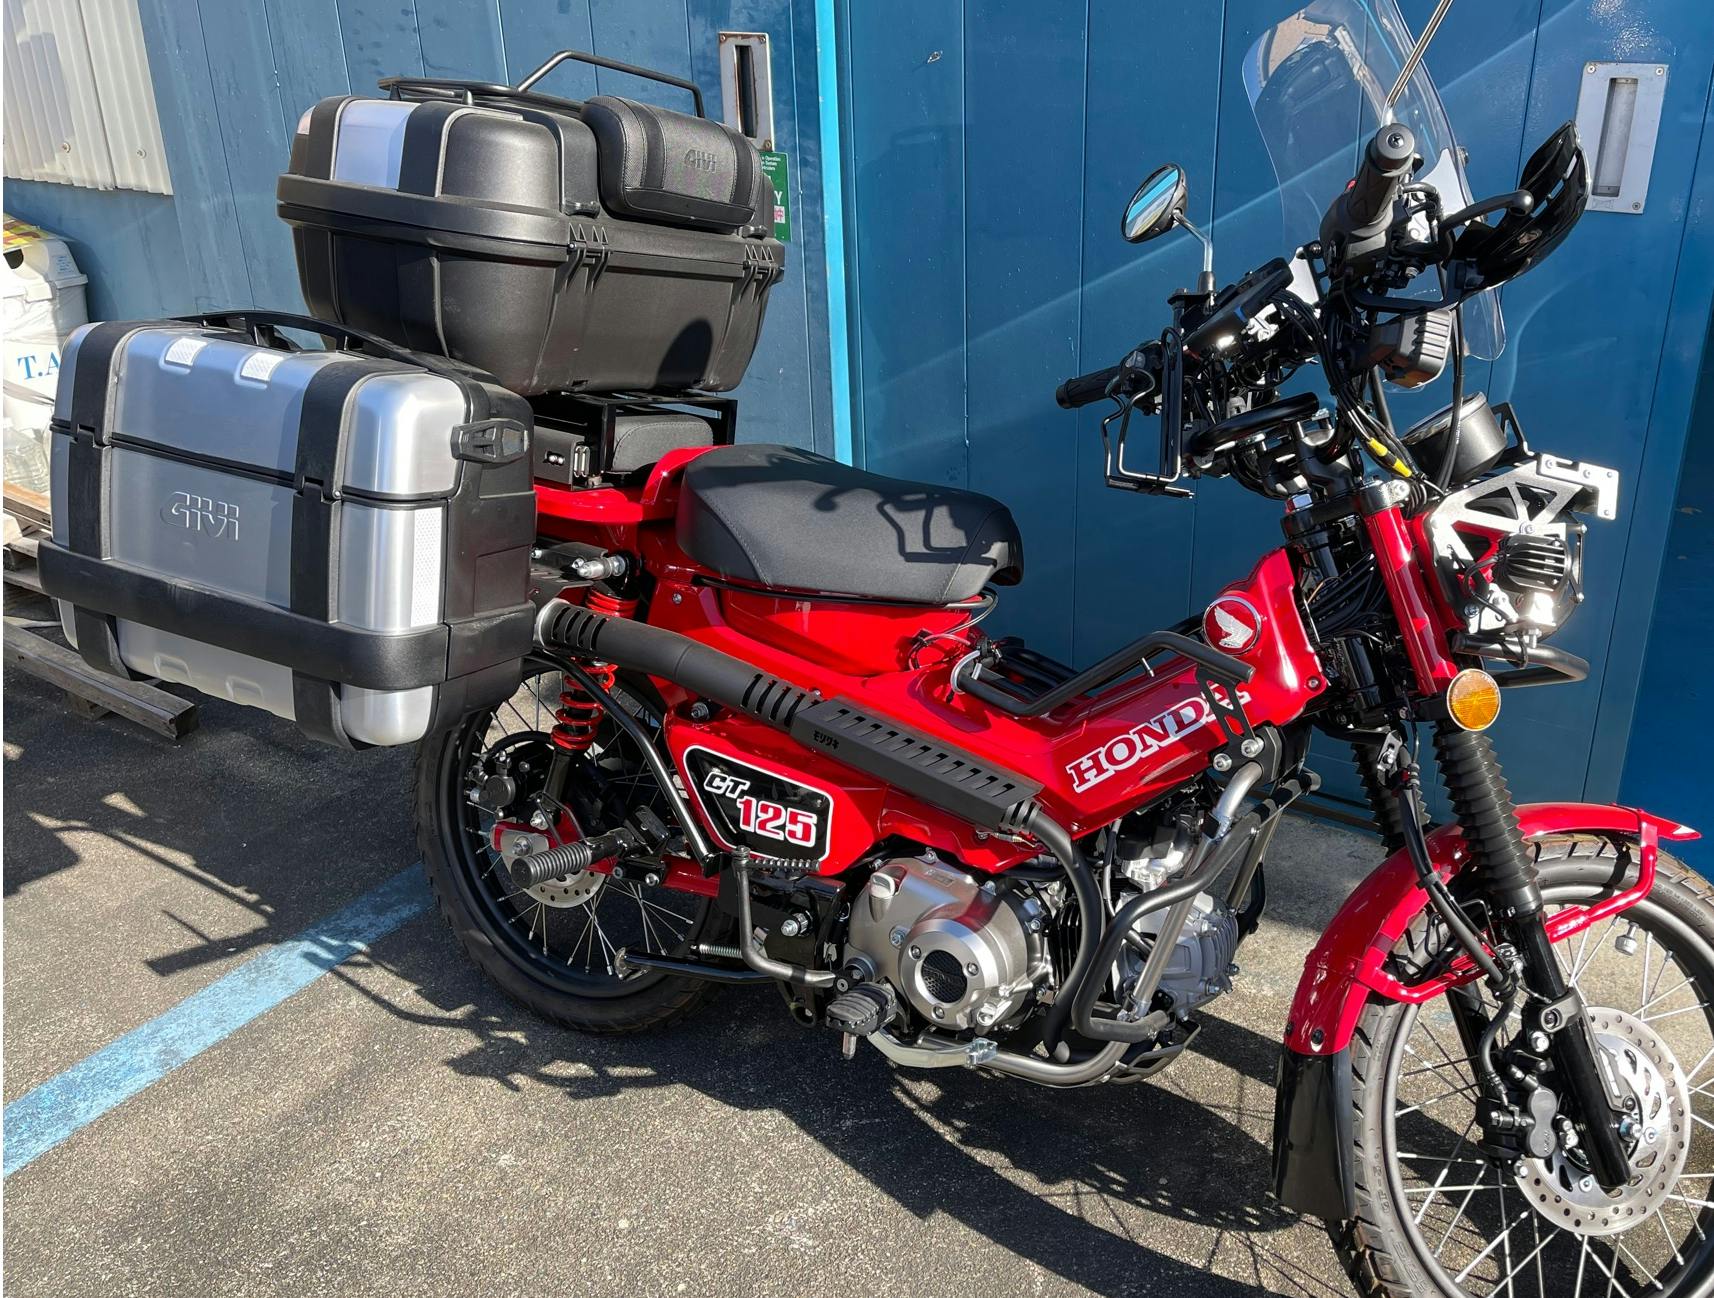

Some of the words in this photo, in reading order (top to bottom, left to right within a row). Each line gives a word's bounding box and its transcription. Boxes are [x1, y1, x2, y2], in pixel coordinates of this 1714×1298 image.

[684, 149, 718, 174] GIVI
[160, 490, 240, 541] GIVI
[703, 771, 751, 799] CT
[736, 795, 818, 848] 125
